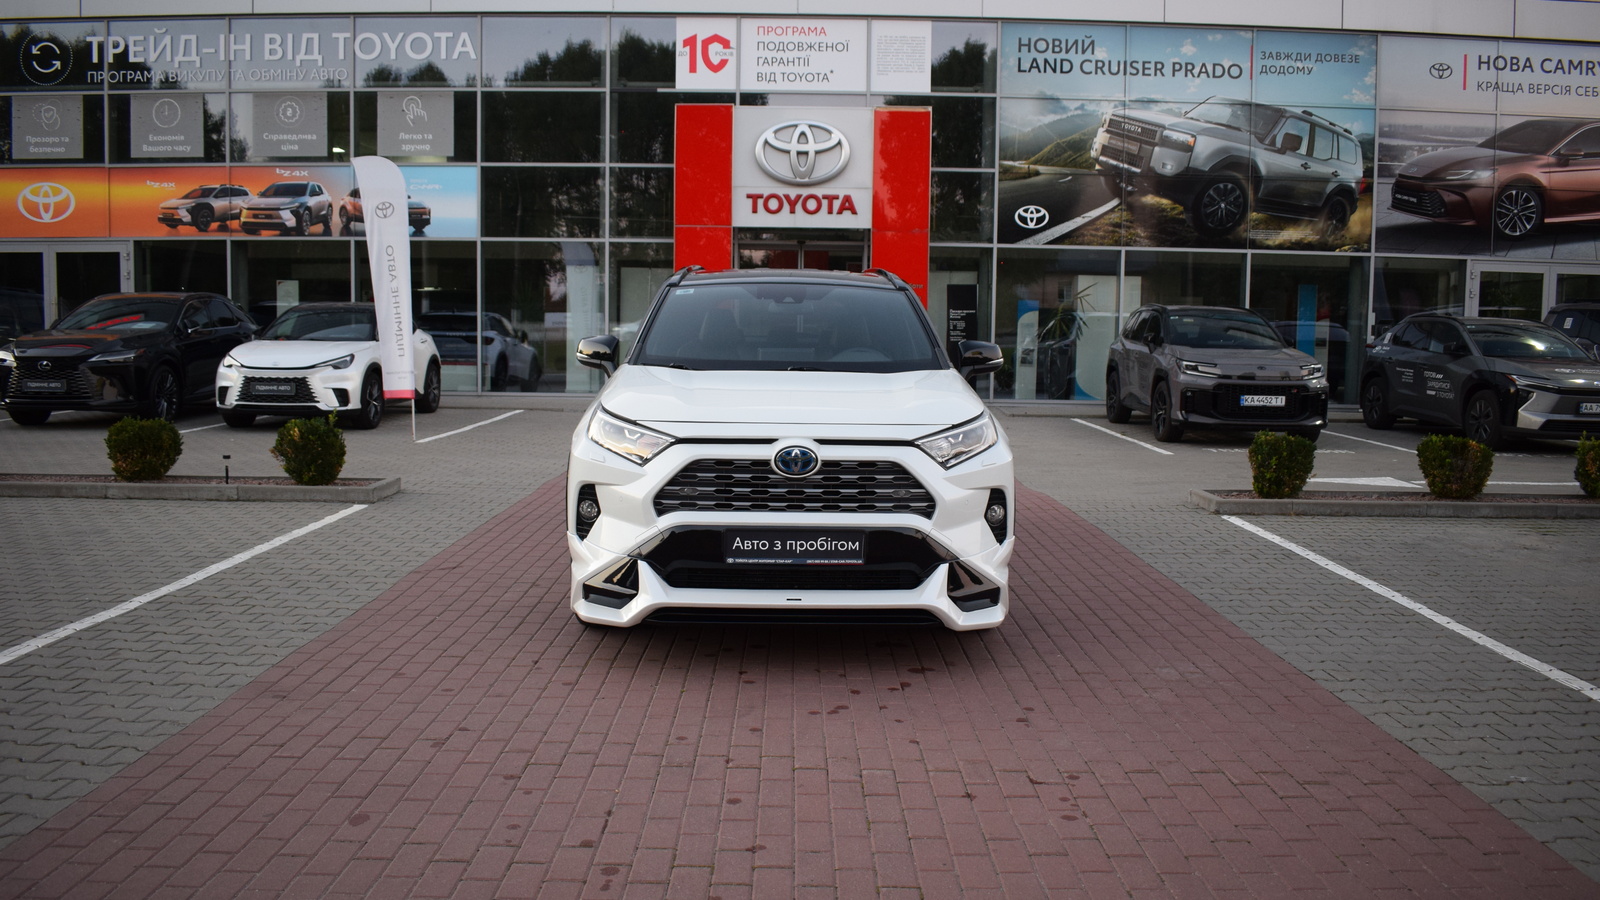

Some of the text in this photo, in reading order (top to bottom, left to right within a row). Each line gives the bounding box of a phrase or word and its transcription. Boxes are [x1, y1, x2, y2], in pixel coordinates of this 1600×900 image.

[757, 26, 827, 36] ПРОГРАМА
[86, 28, 477, 68] ТРЕЙД-ІН ВІД TOYOTA
[756, 40, 850, 52] ПОДОВЖЕНОЇ
[1018, 35, 1096, 55] НОВИЙ
[756, 55, 810, 67] ГАРАНТІЇ
[1260, 51, 1360, 64] ЗАВЖДИ ДОВЕЗЕ
[1017, 57, 1244, 80] LAND CRUISER PRADO
[1478, 55, 1534, 73] НОВА
[87, 68, 348, 83] ПРОГРАМА ВИКУПУ ТА ОБМІНУ АВТО
[1259, 65, 1314, 76] ДОДОМУ
[756, 72, 777, 84] ВІД
[1477, 81, 1524, 95] КРАЩА
[1528, 83, 1571, 96] ВЕРСІЯ
[1121, 122, 1142, 133] TOYOTA
[25, 136, 60, 145] Прозоро
[148, 134, 185, 142] Економія
[263, 132, 317, 142] Справедлива
[399, 132, 422, 141] Легко
[29, 145, 66, 153] безпечно
[143, 144, 192, 153] Вашого часу
[281, 143, 299, 151] ціна
[401, 143, 431, 151] зручно
[746, 193, 858, 215] TOYOTA
[732, 537, 859, 554] Авто з пробігом
